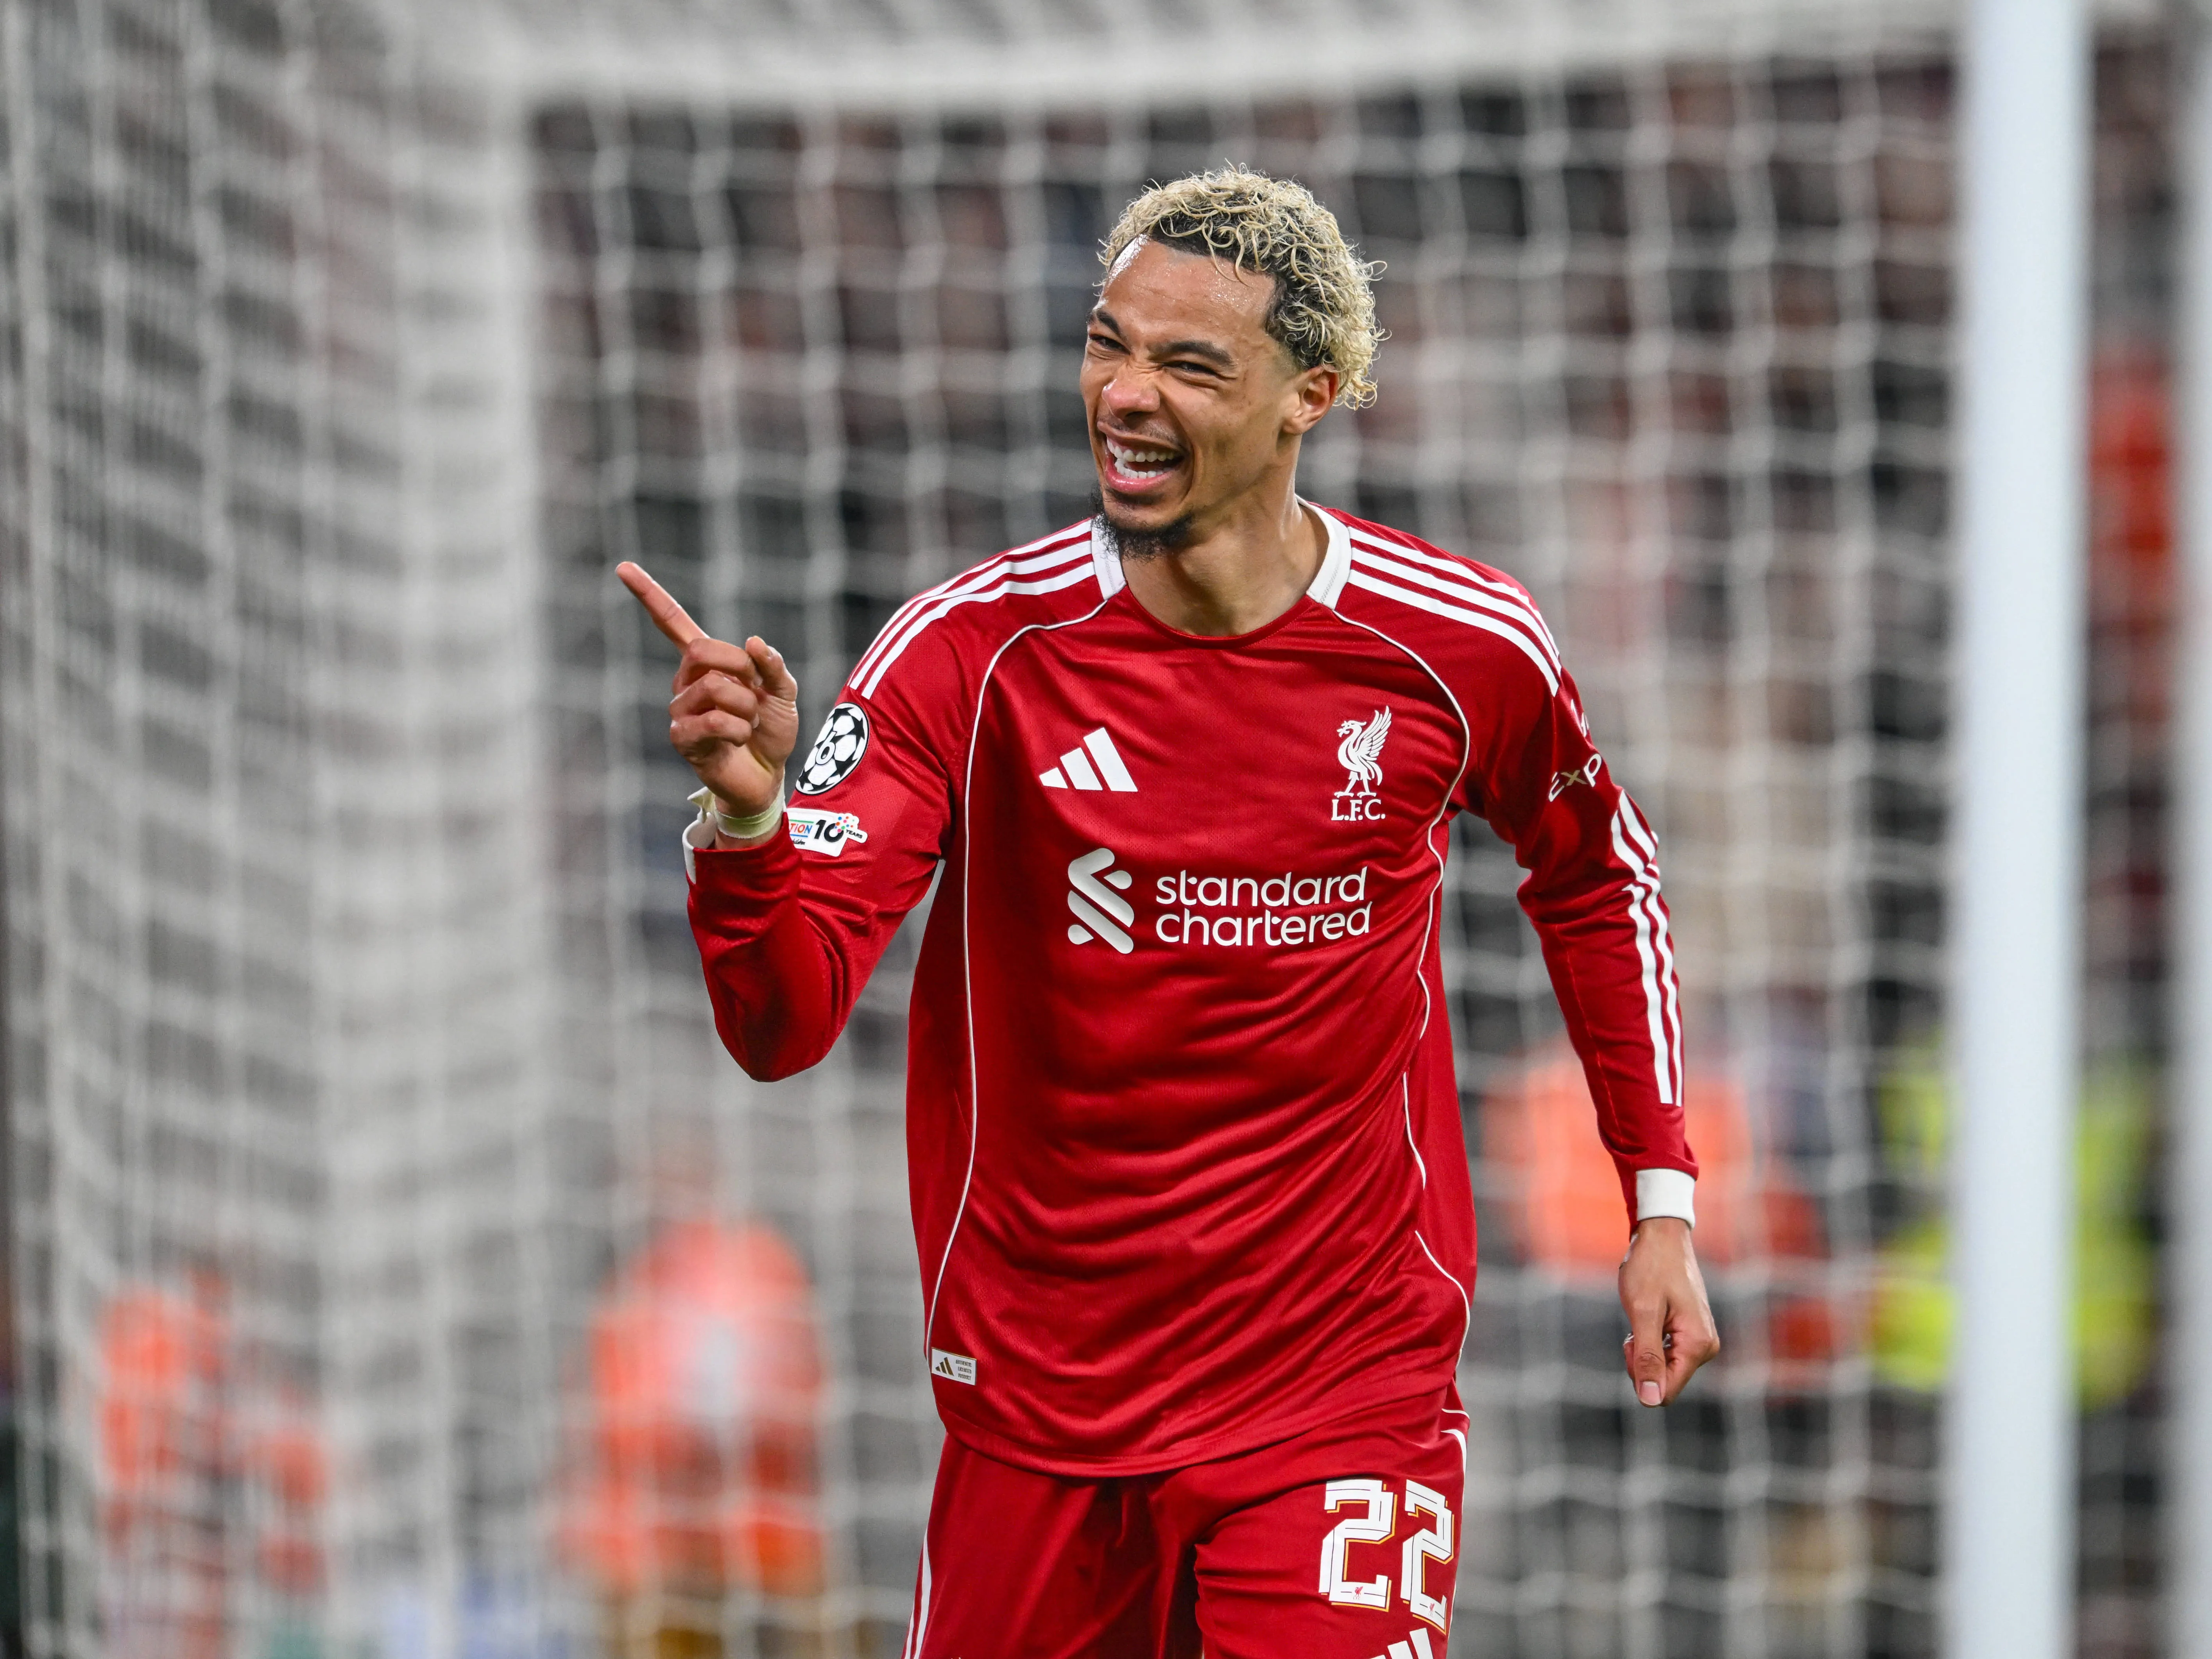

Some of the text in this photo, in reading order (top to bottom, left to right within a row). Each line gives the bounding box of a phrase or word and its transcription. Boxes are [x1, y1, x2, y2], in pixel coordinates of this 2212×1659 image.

[1331, 799, 1386, 821] L.F.C.
[814, 819, 844, 842] 10
[846, 829, 863, 839] YEARS
[1156, 866, 1367, 907] standard
[1156, 901, 1373, 946] chartered
[1318, 1479, 1454, 1636] 22
